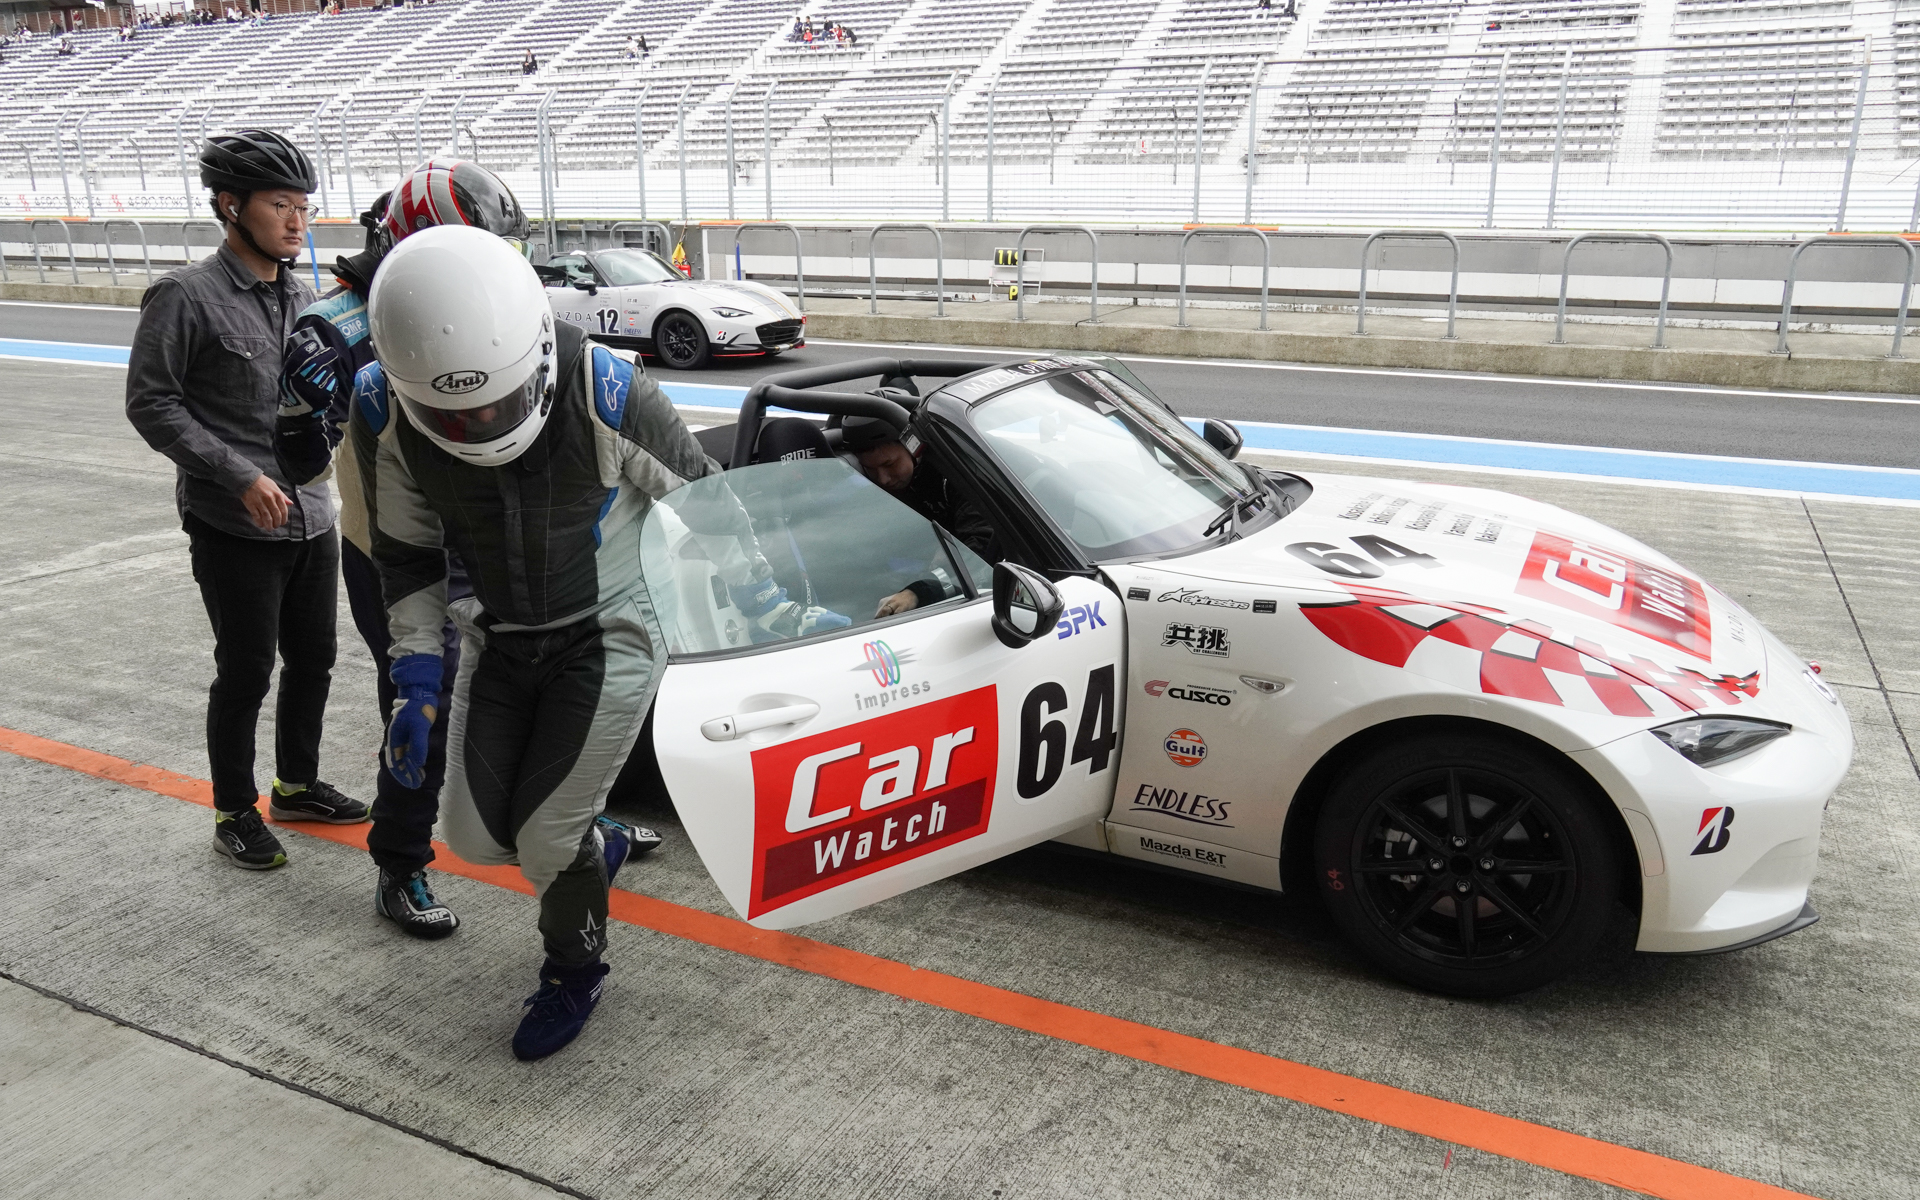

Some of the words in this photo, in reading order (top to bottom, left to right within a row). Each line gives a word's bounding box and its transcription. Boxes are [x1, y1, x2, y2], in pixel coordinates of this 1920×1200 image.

[341, 319, 363, 336] OMP
[556, 311, 593, 322] AZDA
[596, 308, 620, 334] 12
[436, 371, 483, 390] Arai
[963, 368, 1022, 395] MAZDA
[780, 447, 817, 466] BRIDE
[1284, 534, 1445, 579] 64
[1542, 541, 1627, 610] Car
[1183, 594, 1250, 610] alpinestars
[1640, 566, 1687, 622] Watch
[1057, 600, 1107, 640] SPK
[1163, 623, 1229, 651] 共挑
[855, 679, 932, 711] impress
[1168, 687, 1231, 706] CUSCO
[1016, 663, 1117, 800] 64
[1166, 740, 1206, 757] Gulf
[785, 726, 974, 833] Car
[1134, 783, 1231, 820] ENDLESS
[814, 801, 947, 875] Watch
[1140, 836, 1192, 857] Mazda
[1195, 848, 1227, 864] E&T
[1327, 868, 1345, 891] 64
[415, 910, 448, 923] OMP
